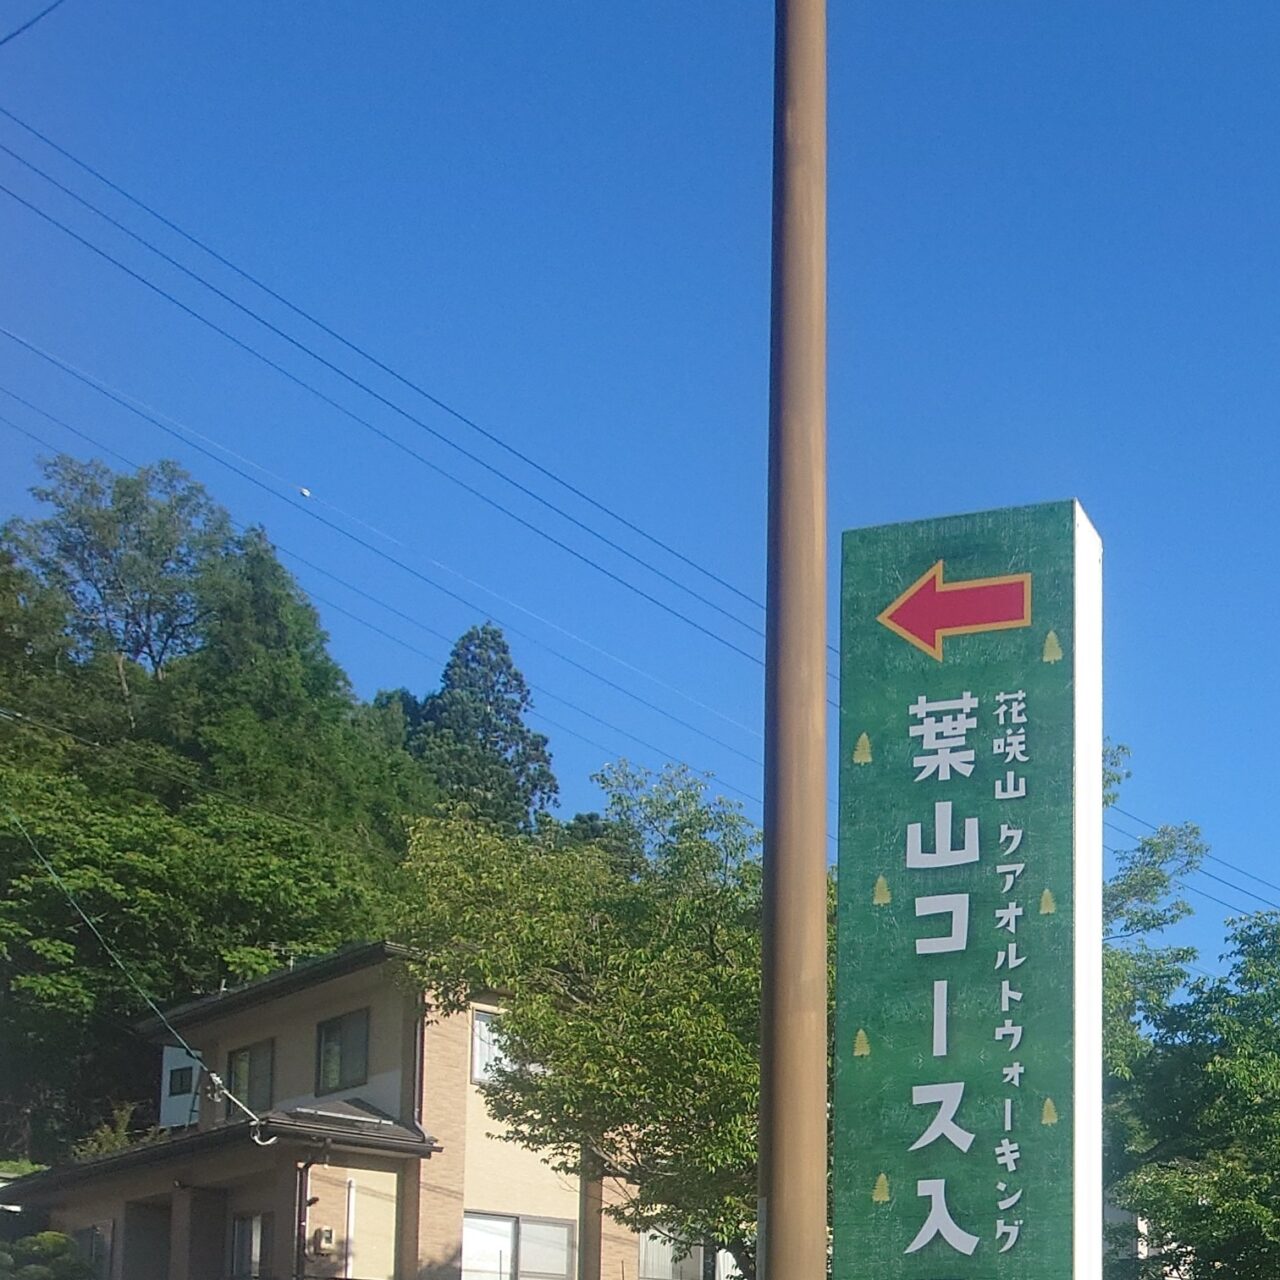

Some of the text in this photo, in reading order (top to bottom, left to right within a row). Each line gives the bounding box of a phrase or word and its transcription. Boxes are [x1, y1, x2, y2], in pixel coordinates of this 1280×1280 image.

[993, 690, 1029, 1254] 花咲山 クアオルトウォーキング
